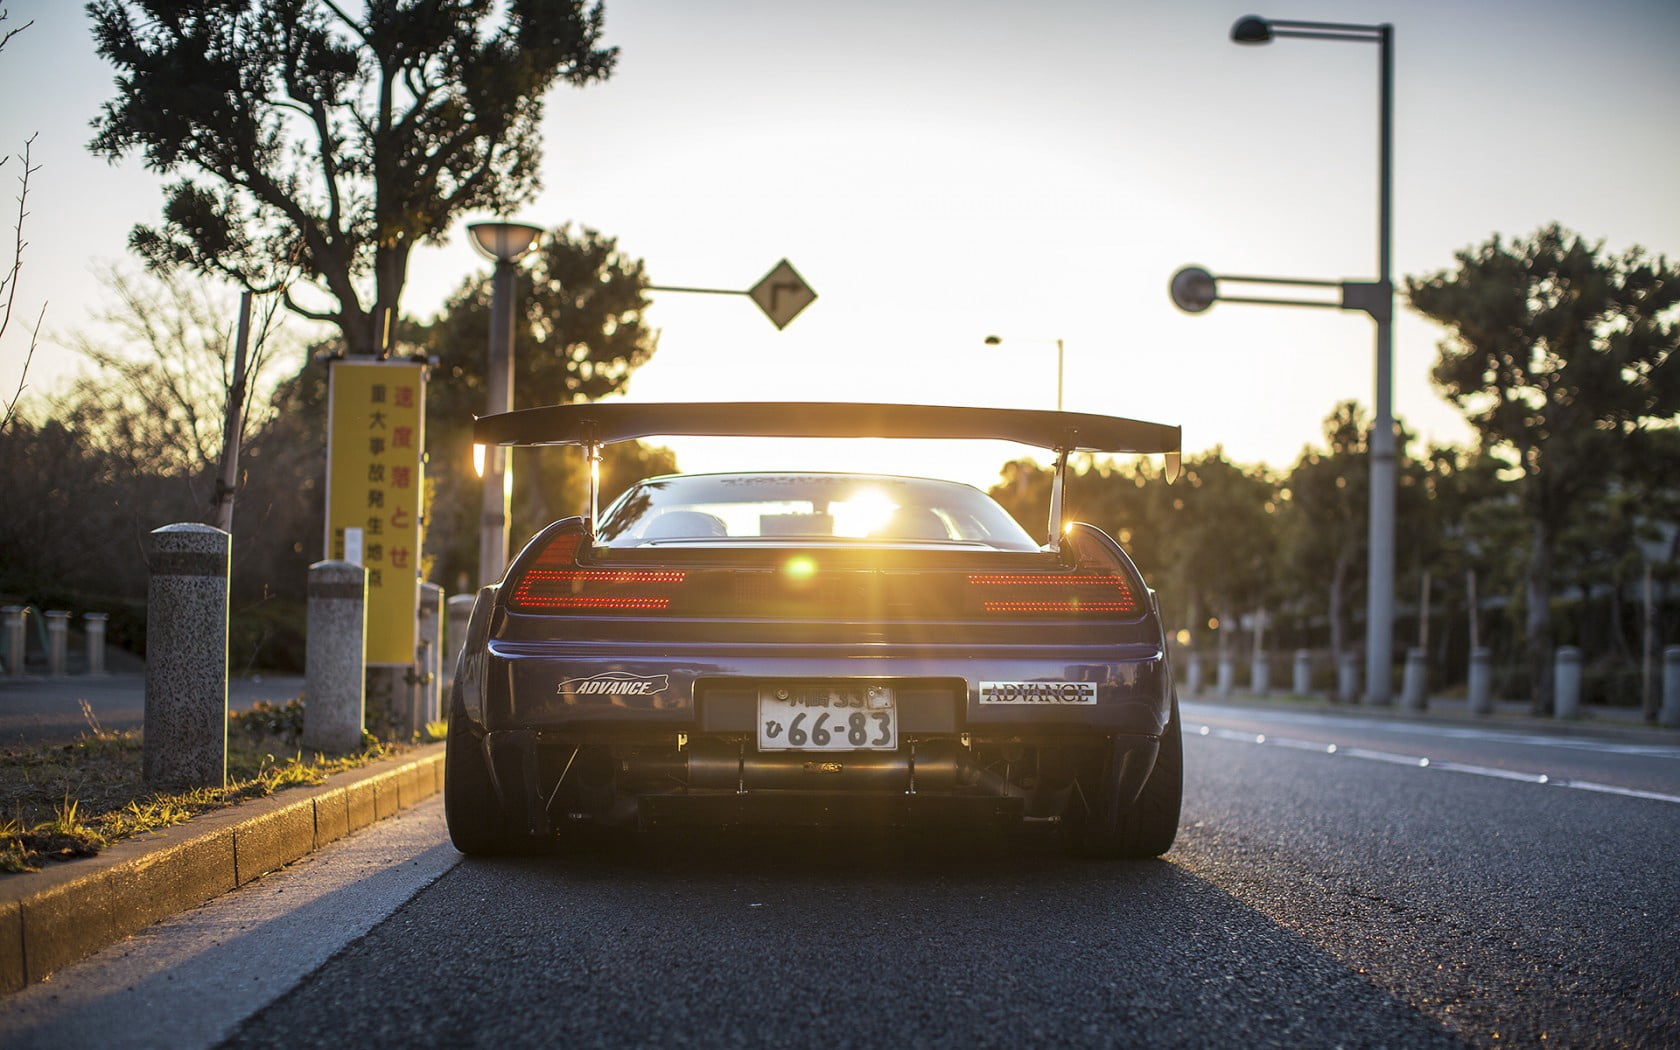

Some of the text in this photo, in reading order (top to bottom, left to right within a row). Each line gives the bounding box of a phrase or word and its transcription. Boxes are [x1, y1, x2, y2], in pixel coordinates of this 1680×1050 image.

[367, 384, 386, 587] 重大事故発生地点
[390, 386, 413, 568] 速度落とせ
[575, 681, 652, 695] ADVANCE
[986, 684, 1089, 702] ADVANCE
[788, 712, 891, 746] 66-83
